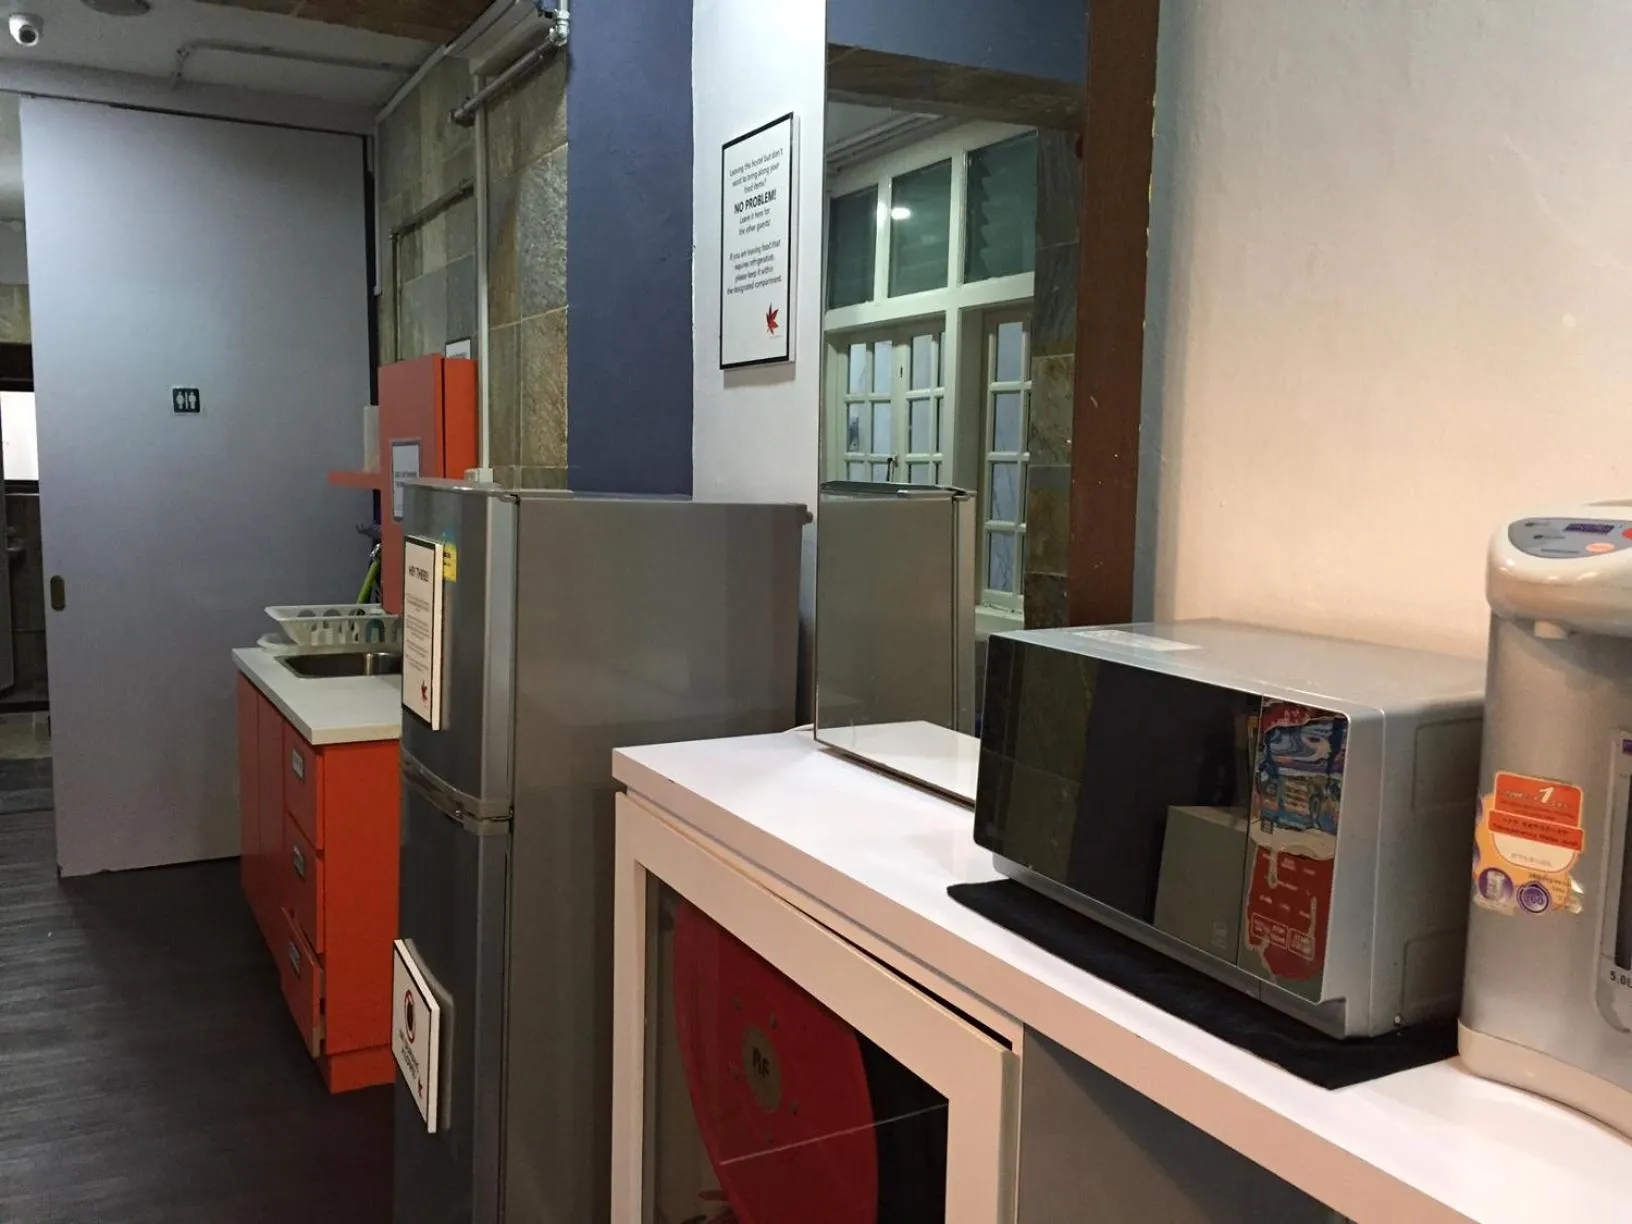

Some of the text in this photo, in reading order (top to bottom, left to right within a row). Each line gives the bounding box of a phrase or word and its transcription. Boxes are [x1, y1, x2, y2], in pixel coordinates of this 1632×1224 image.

[730, 165, 744, 177] Leaving
[764, 153, 772, 162] but
[734, 188, 776, 214] NO PROBLEM!
[1539, 786, 1555, 804] 1
